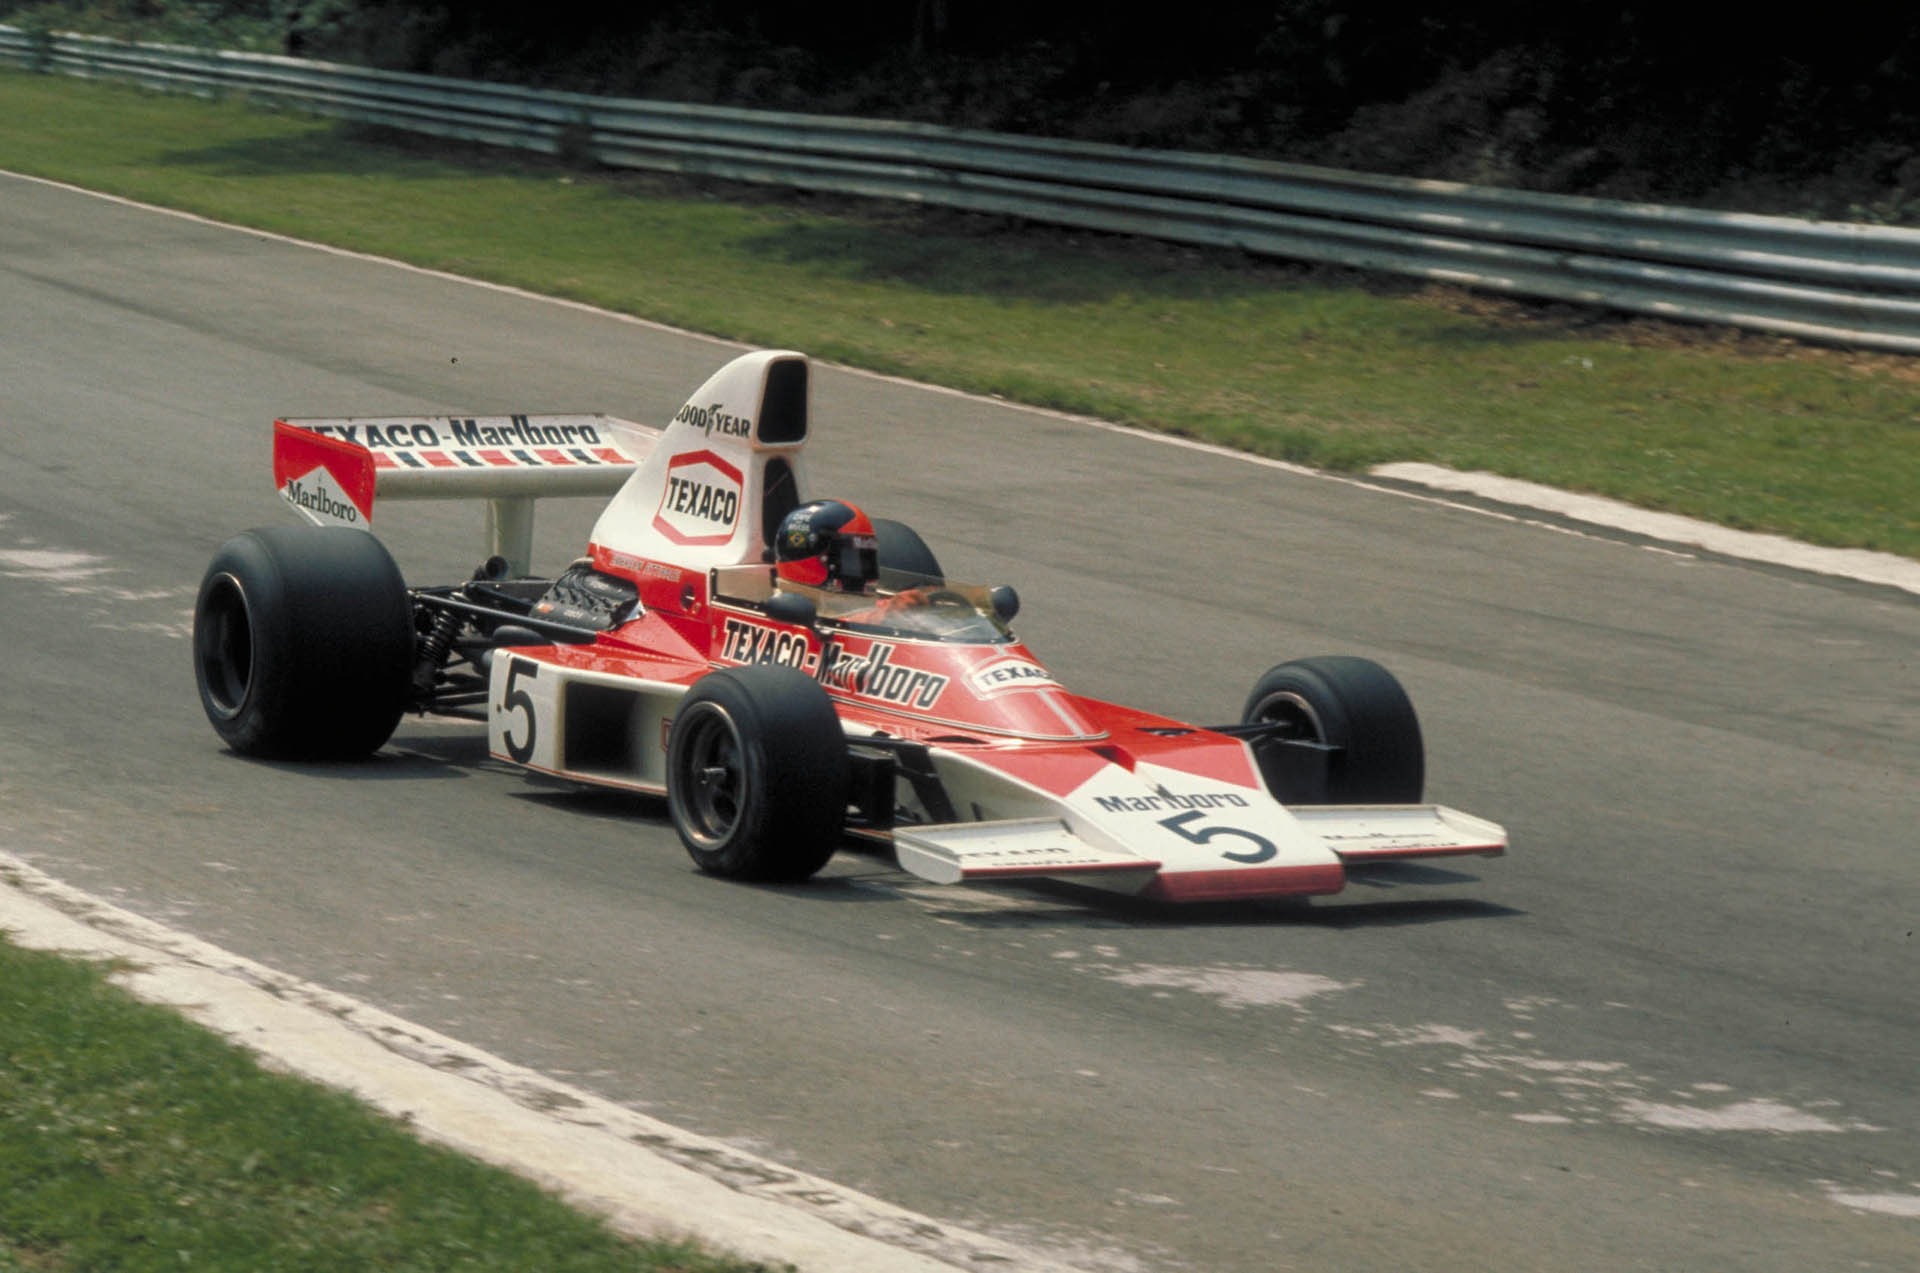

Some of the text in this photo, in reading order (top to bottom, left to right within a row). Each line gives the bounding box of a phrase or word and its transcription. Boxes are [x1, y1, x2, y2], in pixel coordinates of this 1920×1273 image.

[676, 404, 708, 427] OOD
[287, 479, 357, 522] Marlboro
[667, 476, 738, 525] TEXACO
[503, 657, 539, 764] 5
[1092, 784, 1251, 813] Marlboro
[1157, 810, 1278, 864] 5
